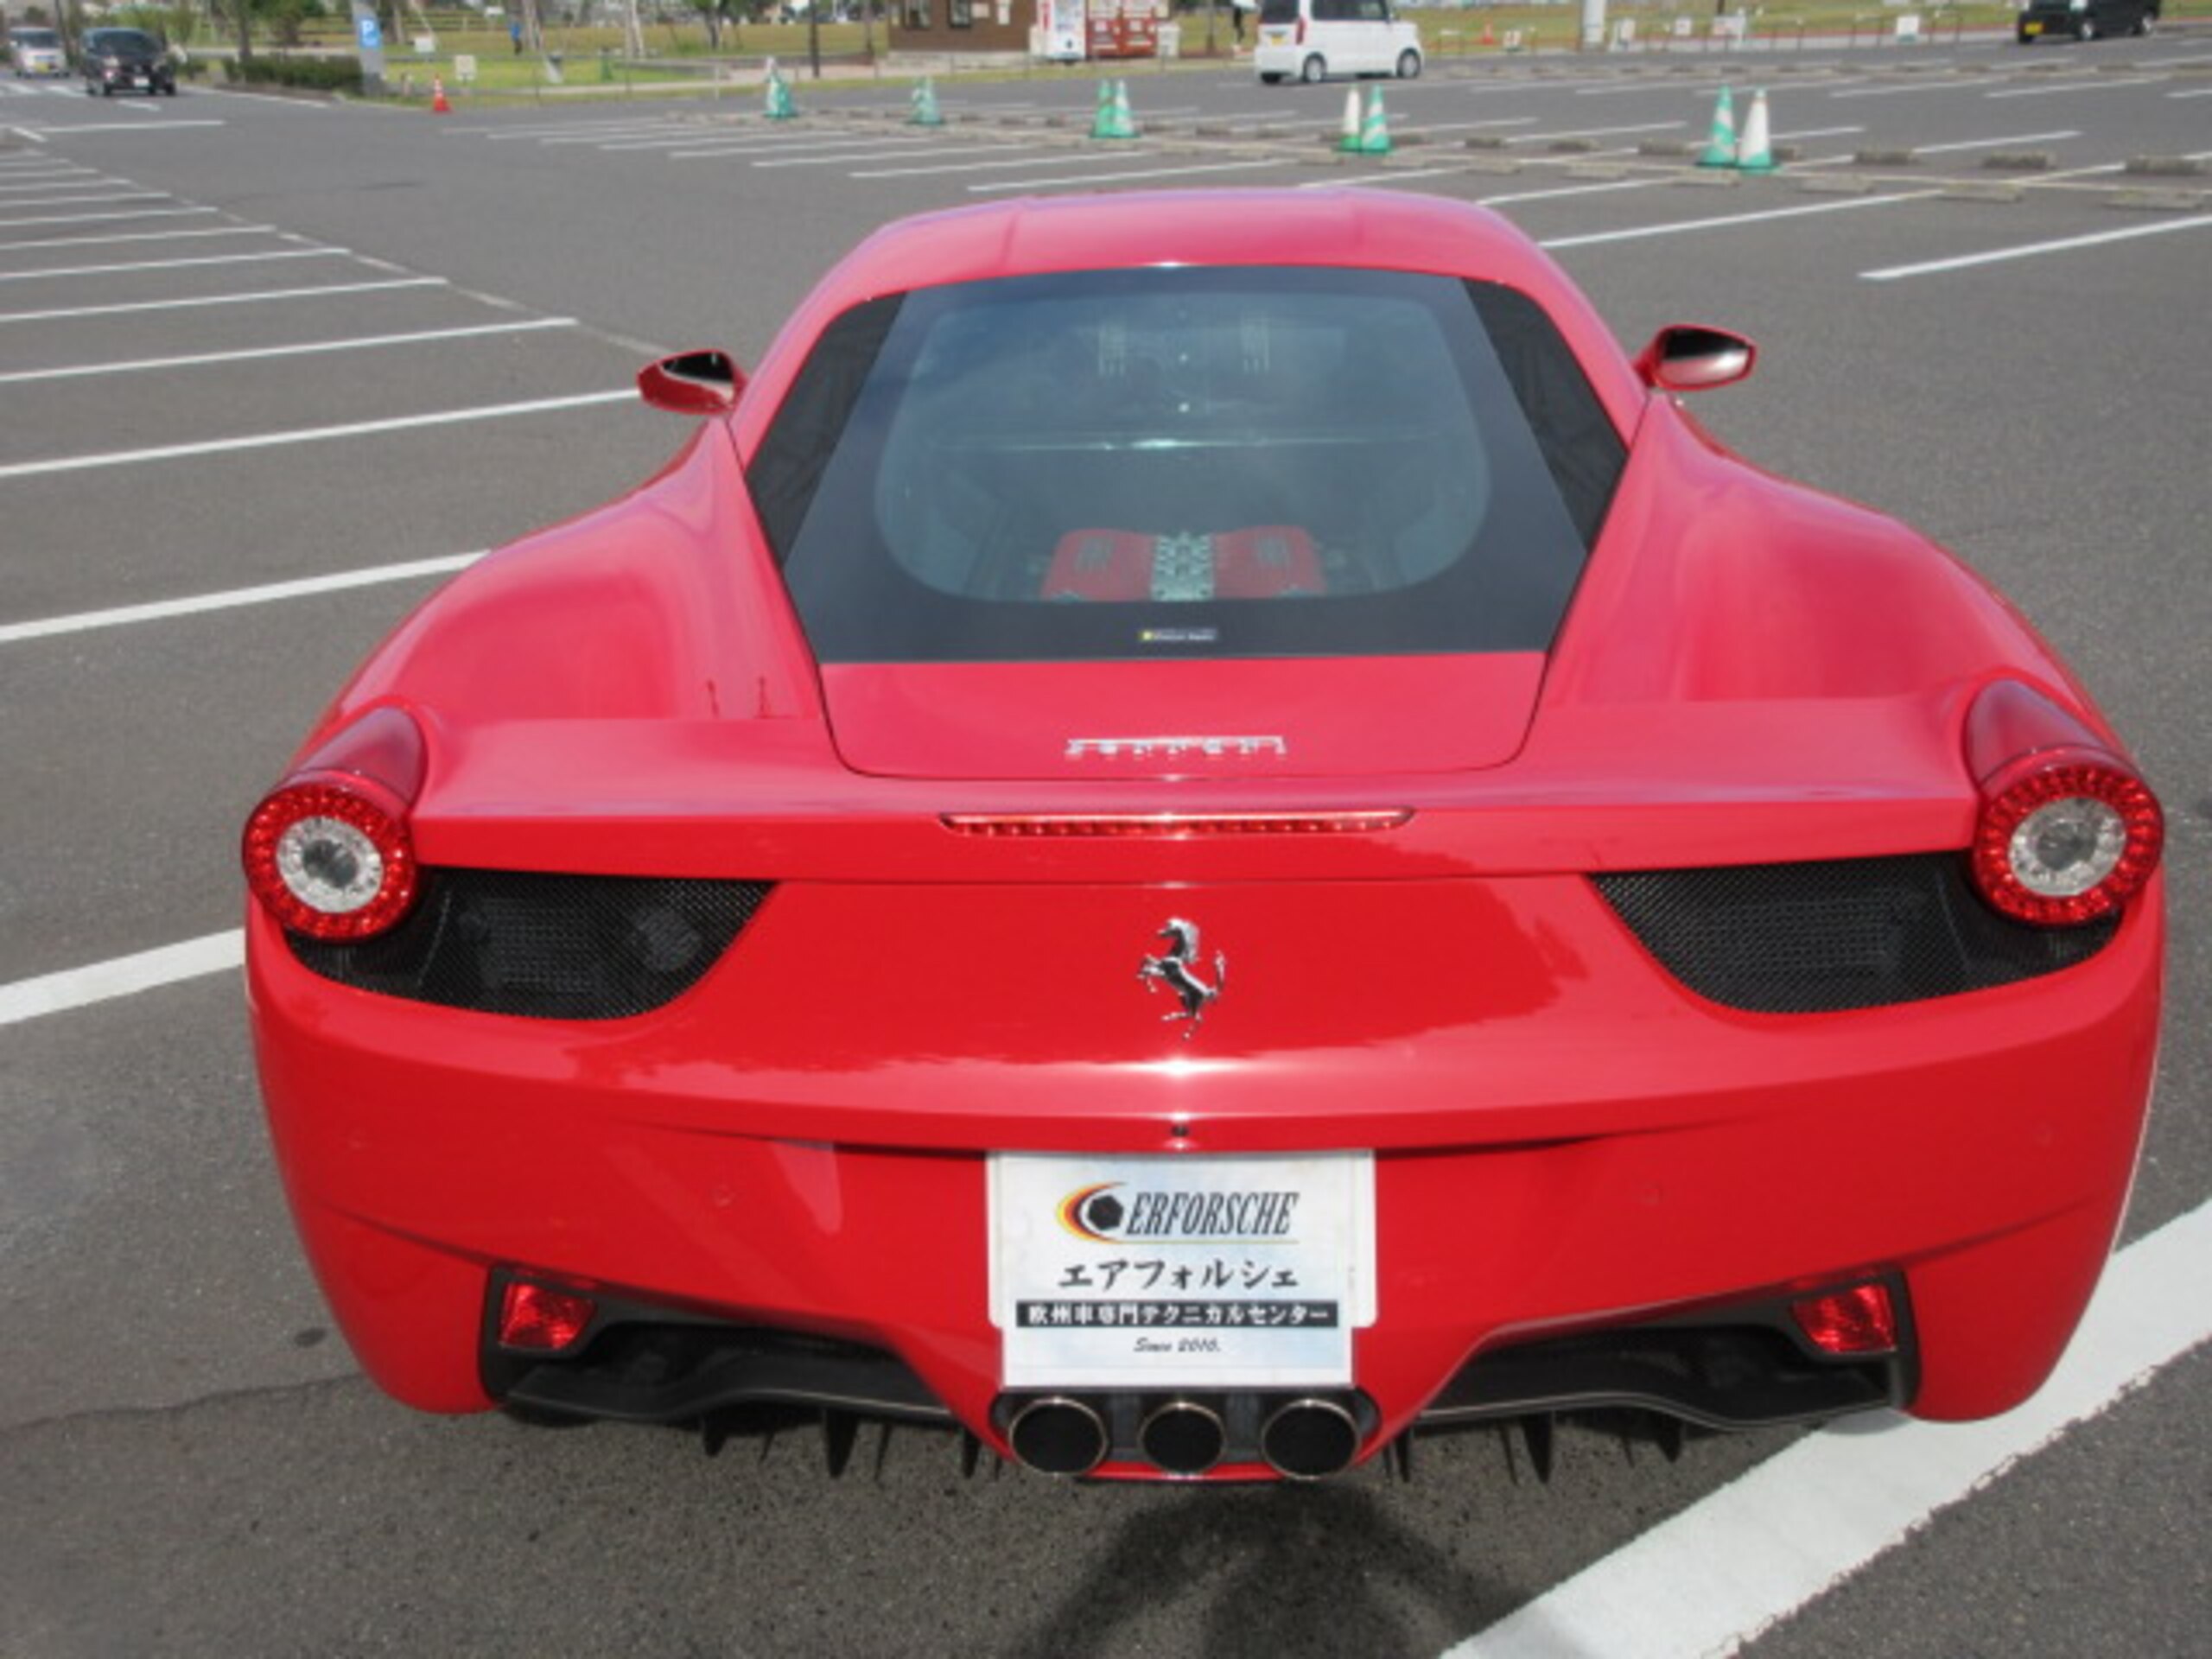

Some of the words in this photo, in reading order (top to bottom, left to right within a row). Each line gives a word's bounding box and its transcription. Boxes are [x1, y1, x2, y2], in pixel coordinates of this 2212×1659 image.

[361, 19, 375, 37] P
[1058, 1258, 1299, 1292] エアフォルシェ
